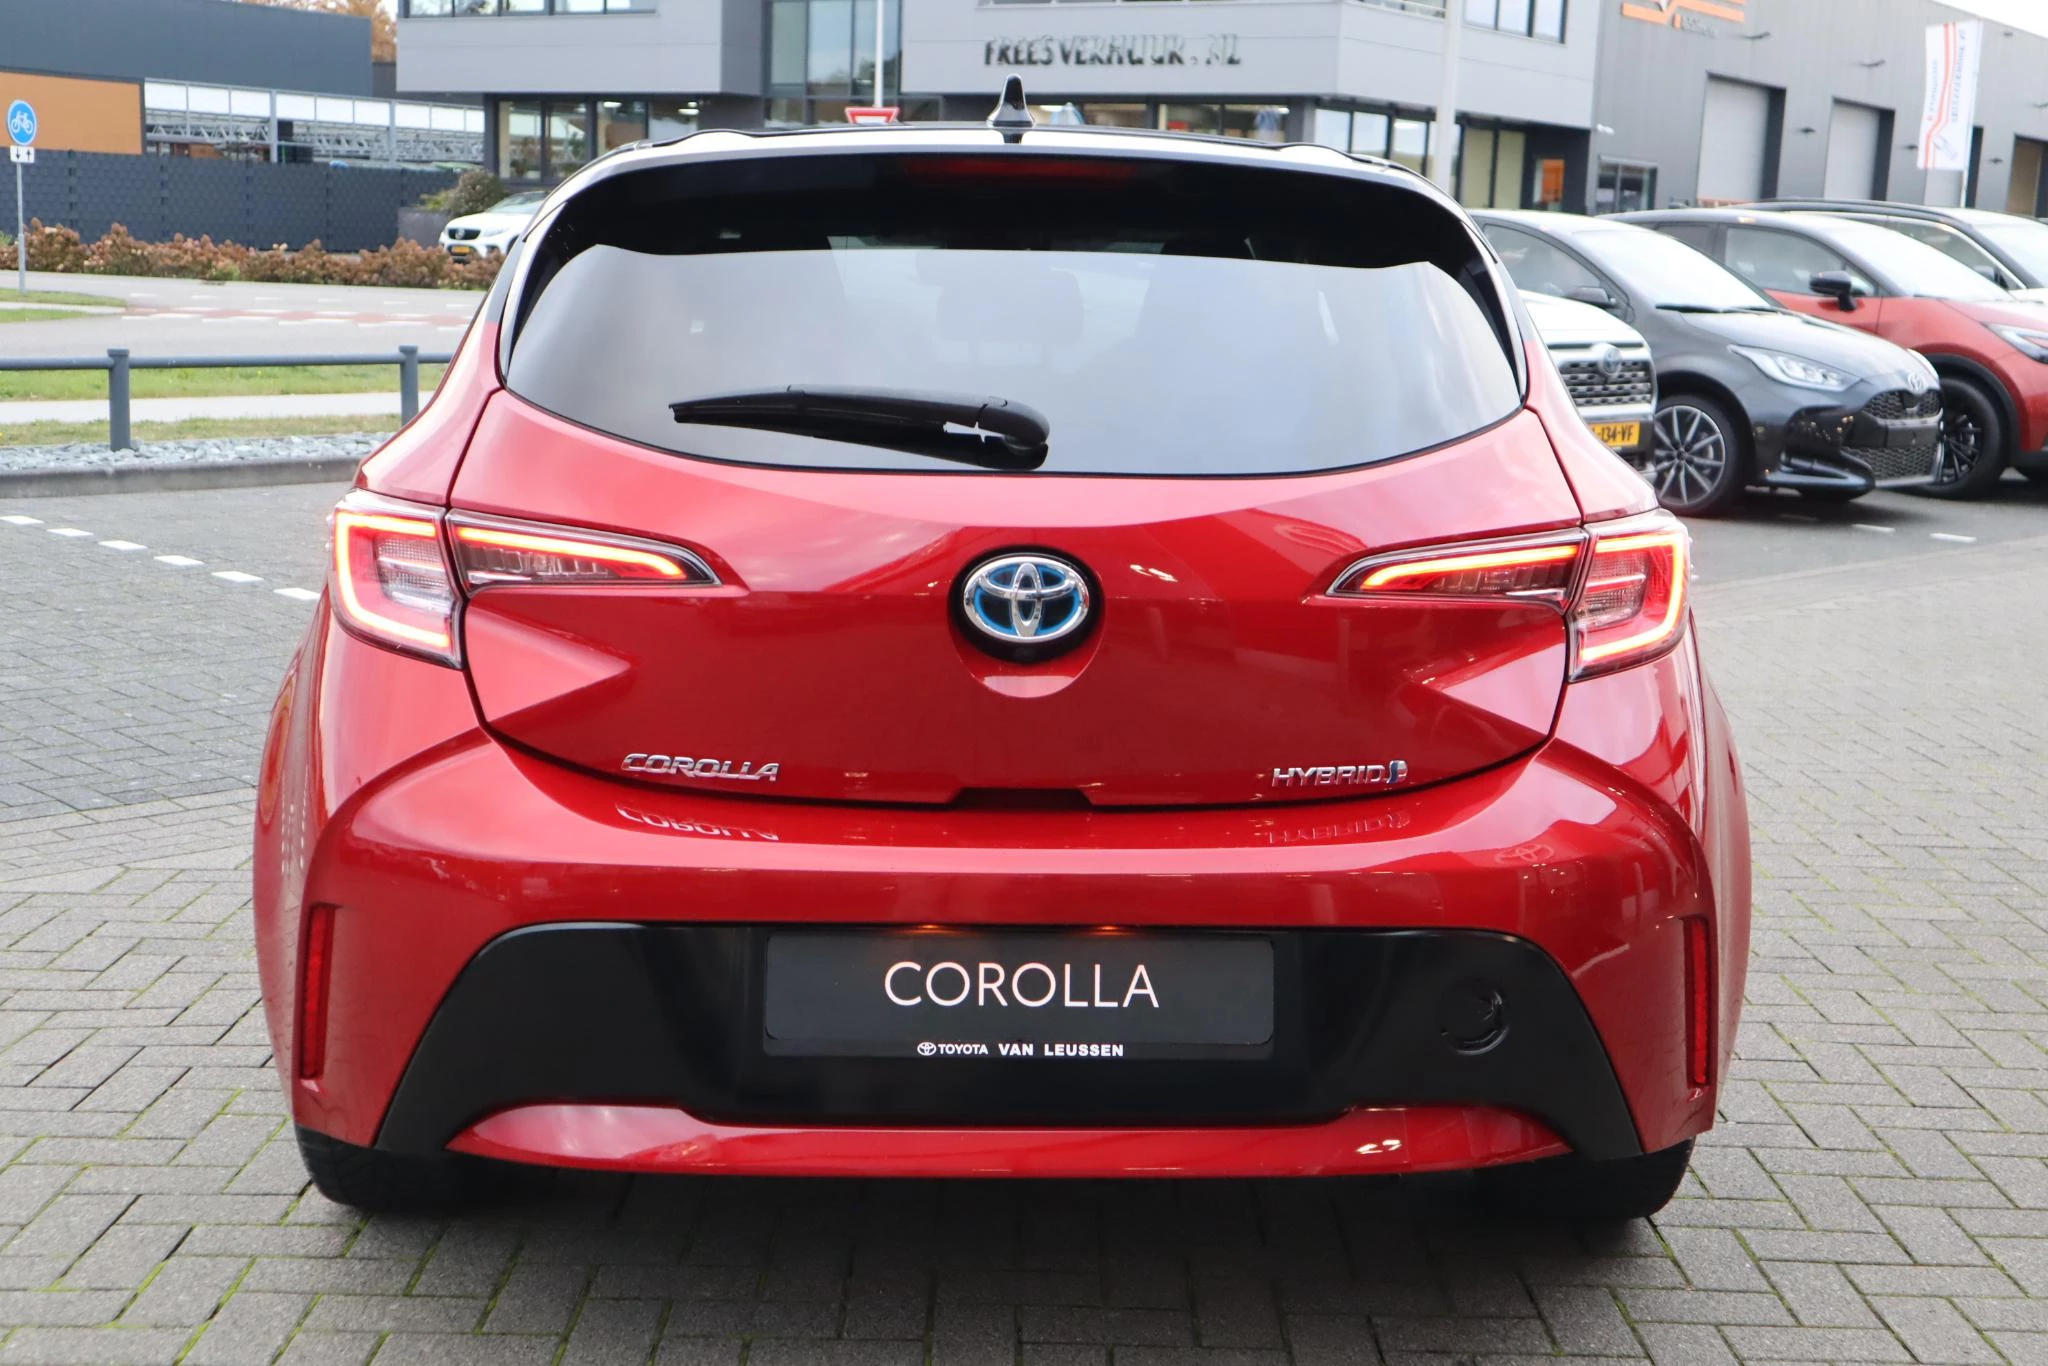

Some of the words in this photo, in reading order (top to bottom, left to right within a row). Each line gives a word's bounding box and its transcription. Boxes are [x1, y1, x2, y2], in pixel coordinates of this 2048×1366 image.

[620, 753, 780, 782] COROLLA
[1271, 764, 1386, 788] HYBRID
[884, 961, 1160, 1008] COROLLA
[938, 1043, 989, 1056] TOYOTA
[998, 1043, 1034, 1057] VAN
[1043, 1043, 1124, 1058] LEUSSEN
